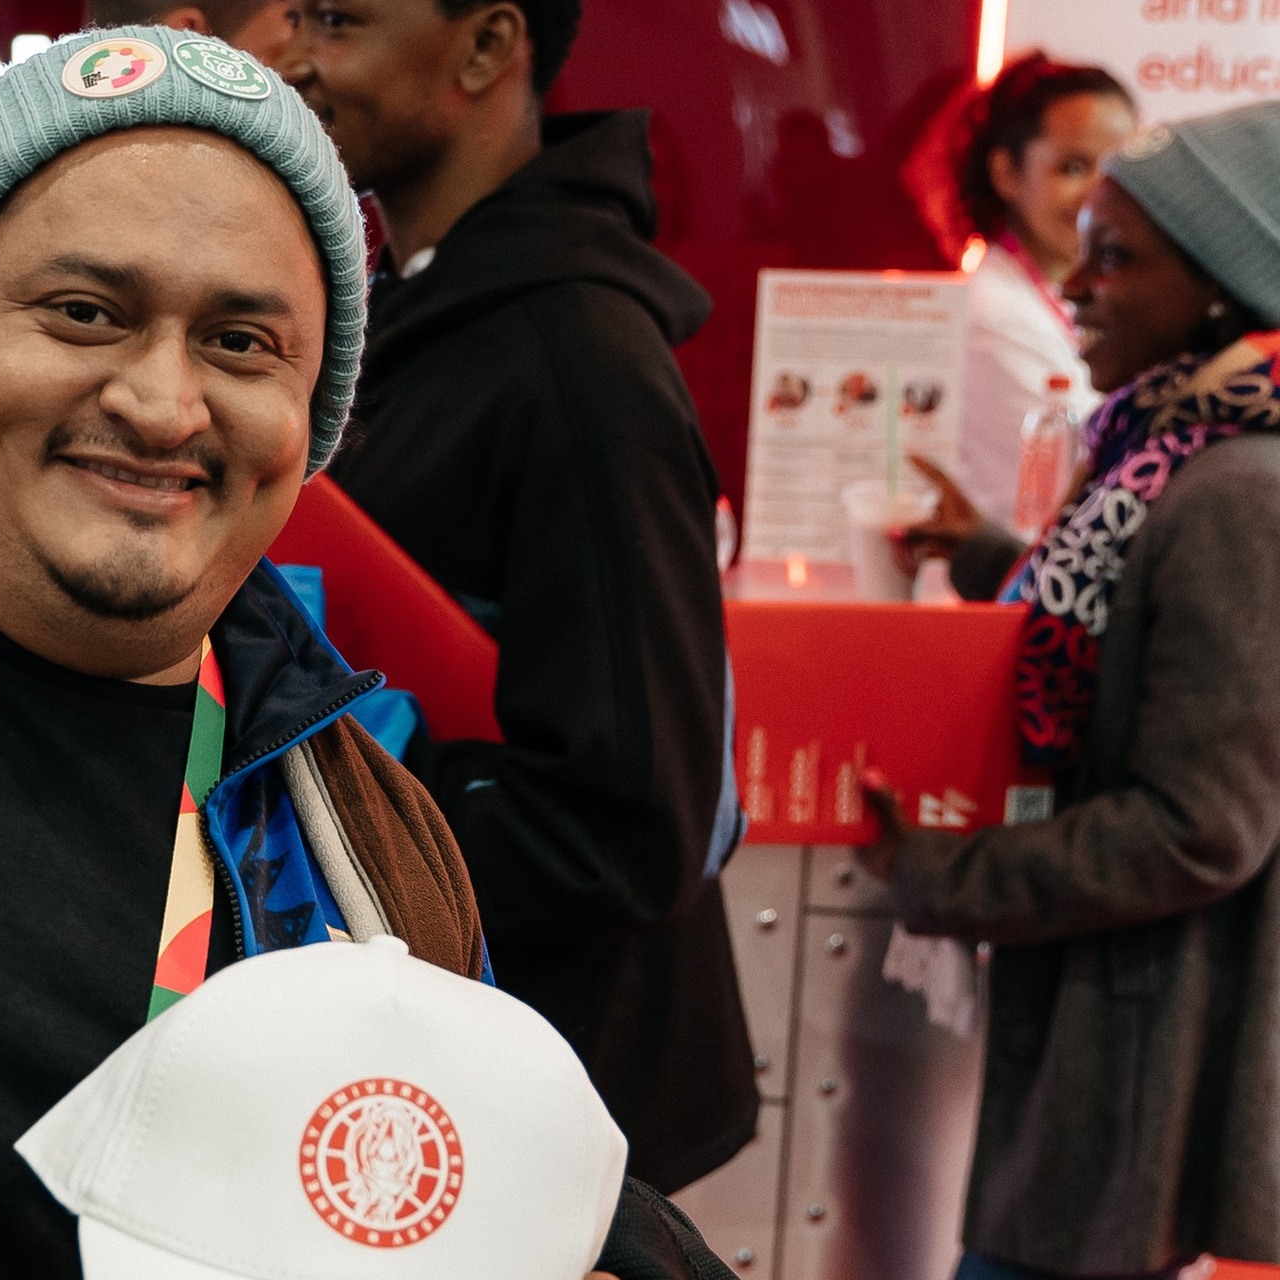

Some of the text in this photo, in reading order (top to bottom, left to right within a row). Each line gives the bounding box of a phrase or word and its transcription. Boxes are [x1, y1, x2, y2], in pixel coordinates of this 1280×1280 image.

[1137, 42, 1280, 90] educ
[301, 1079, 463, 1246] SYNERGY UNIVERSITY EMBASSY
